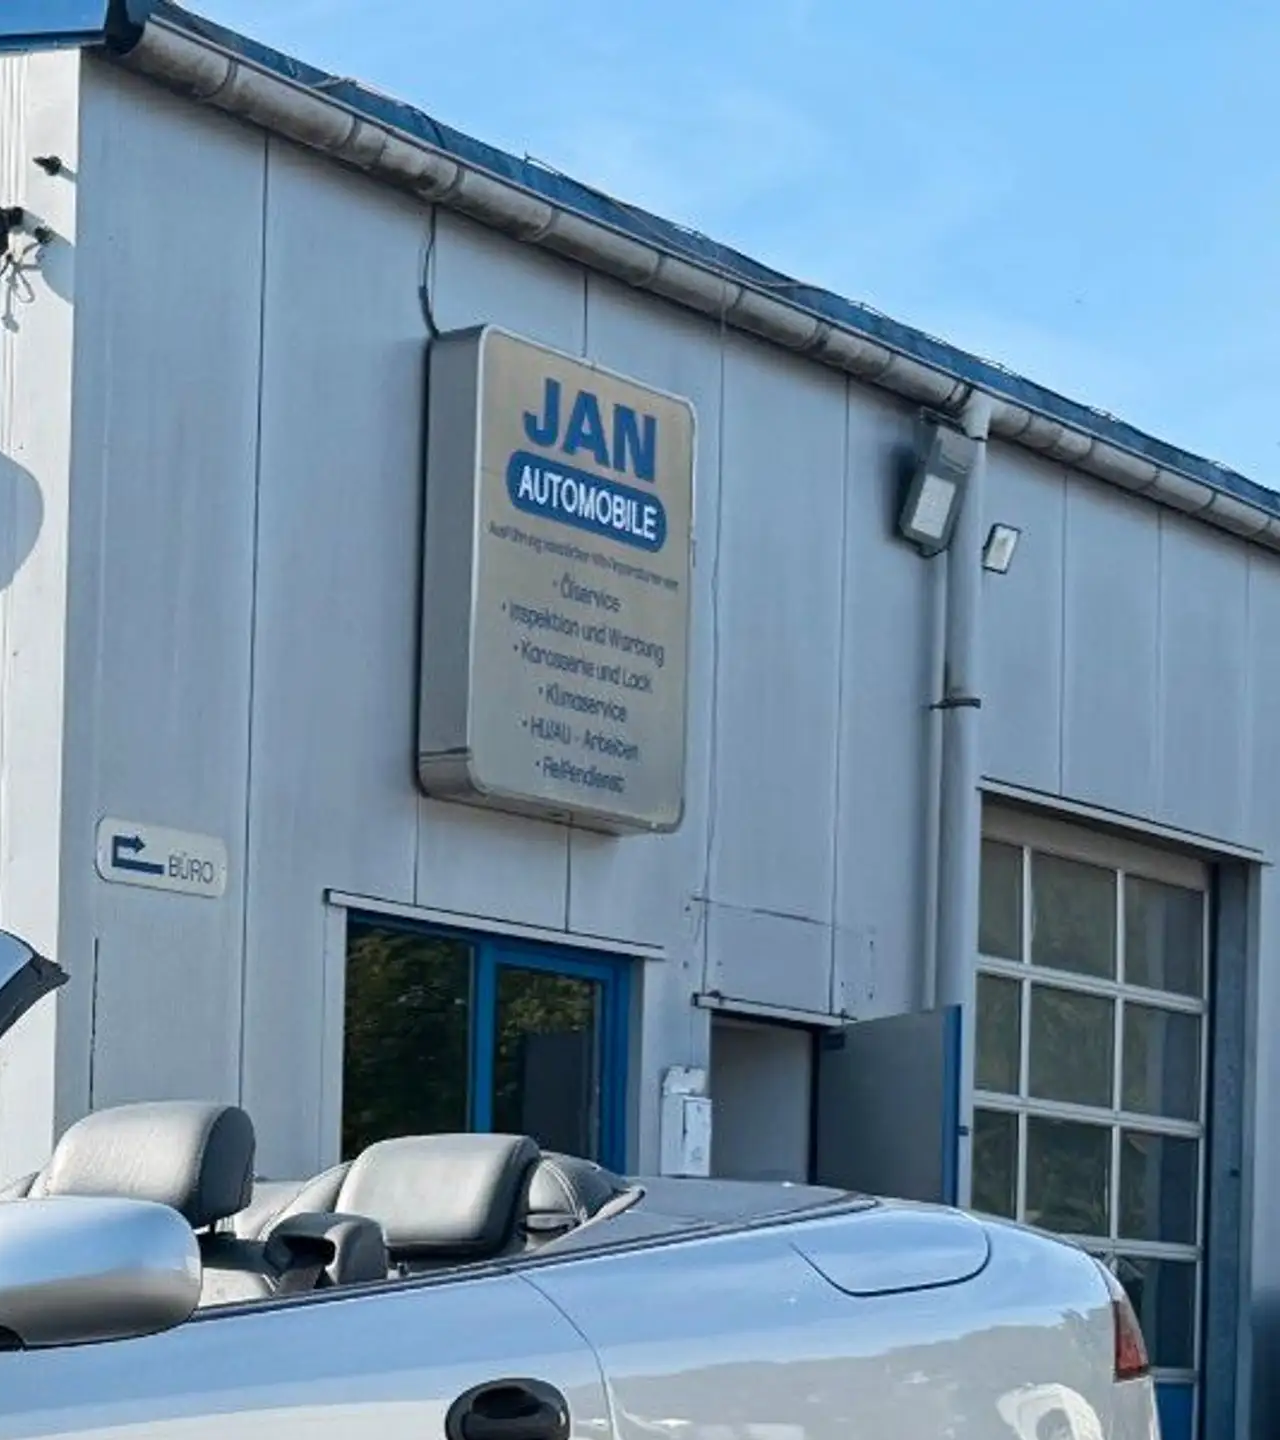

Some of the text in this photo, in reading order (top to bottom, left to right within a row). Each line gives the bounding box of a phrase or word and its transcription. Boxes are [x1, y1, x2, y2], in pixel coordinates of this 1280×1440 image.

[523, 377, 658, 484] JAN
[517, 465, 658, 541] AUTOMOBILE
[582, 624, 607, 645] und
[597, 662, 621, 685] und
[168, 851, 214, 884] BÜRO
